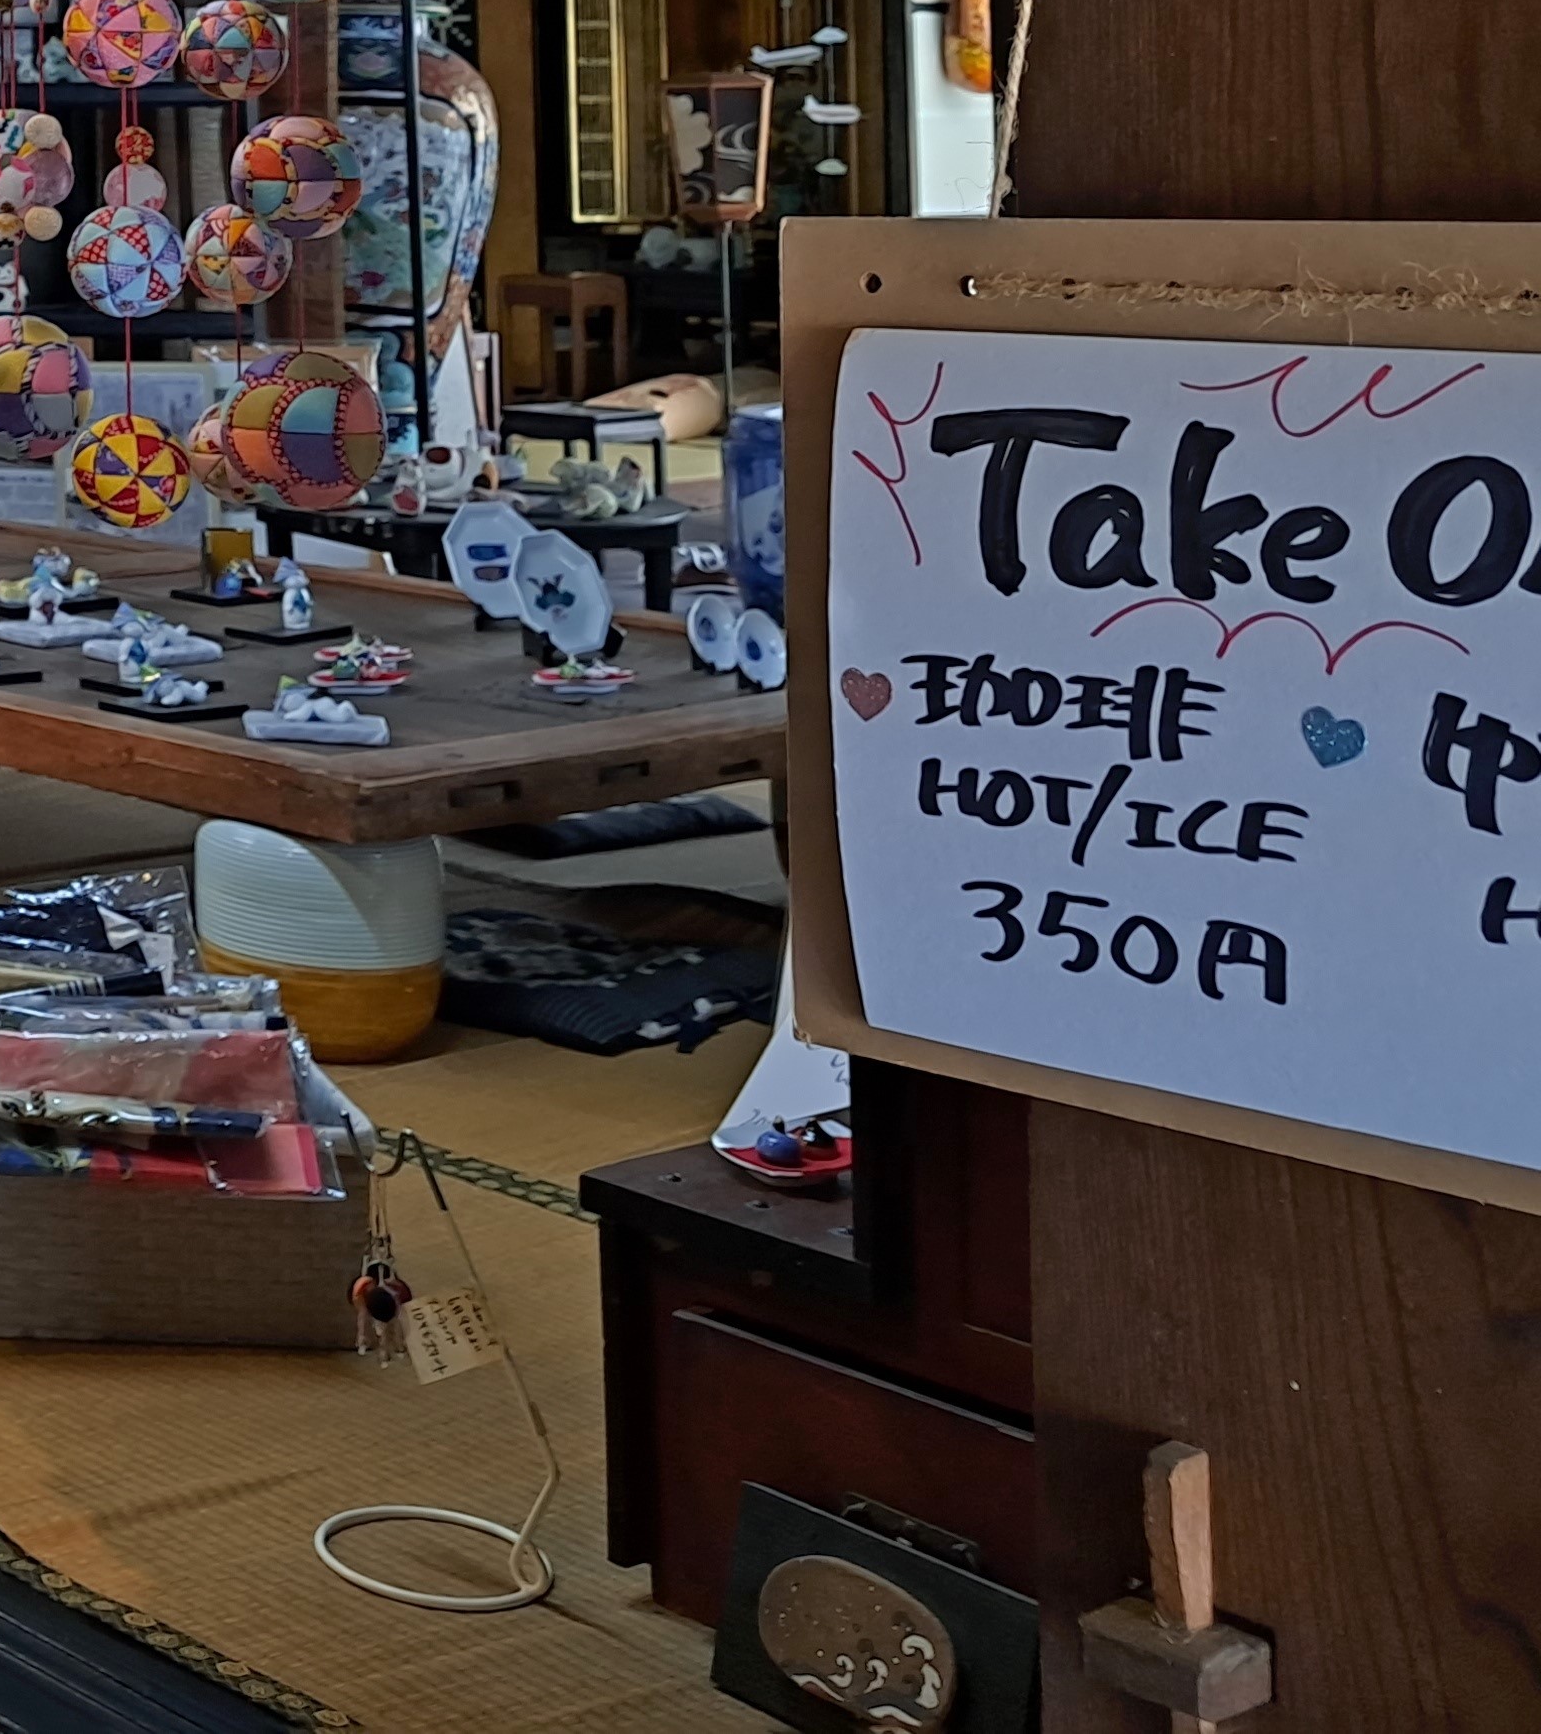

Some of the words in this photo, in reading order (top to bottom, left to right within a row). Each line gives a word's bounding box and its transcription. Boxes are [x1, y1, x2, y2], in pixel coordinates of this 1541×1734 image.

[930, 408, 1350, 603] Take
[1387, 455, 1541, 607] O
[900, 653, 1226, 762] 珈琲
[918, 758, 1310, 867] HOT/ICE
[961, 881, 1287, 1005] 350円
